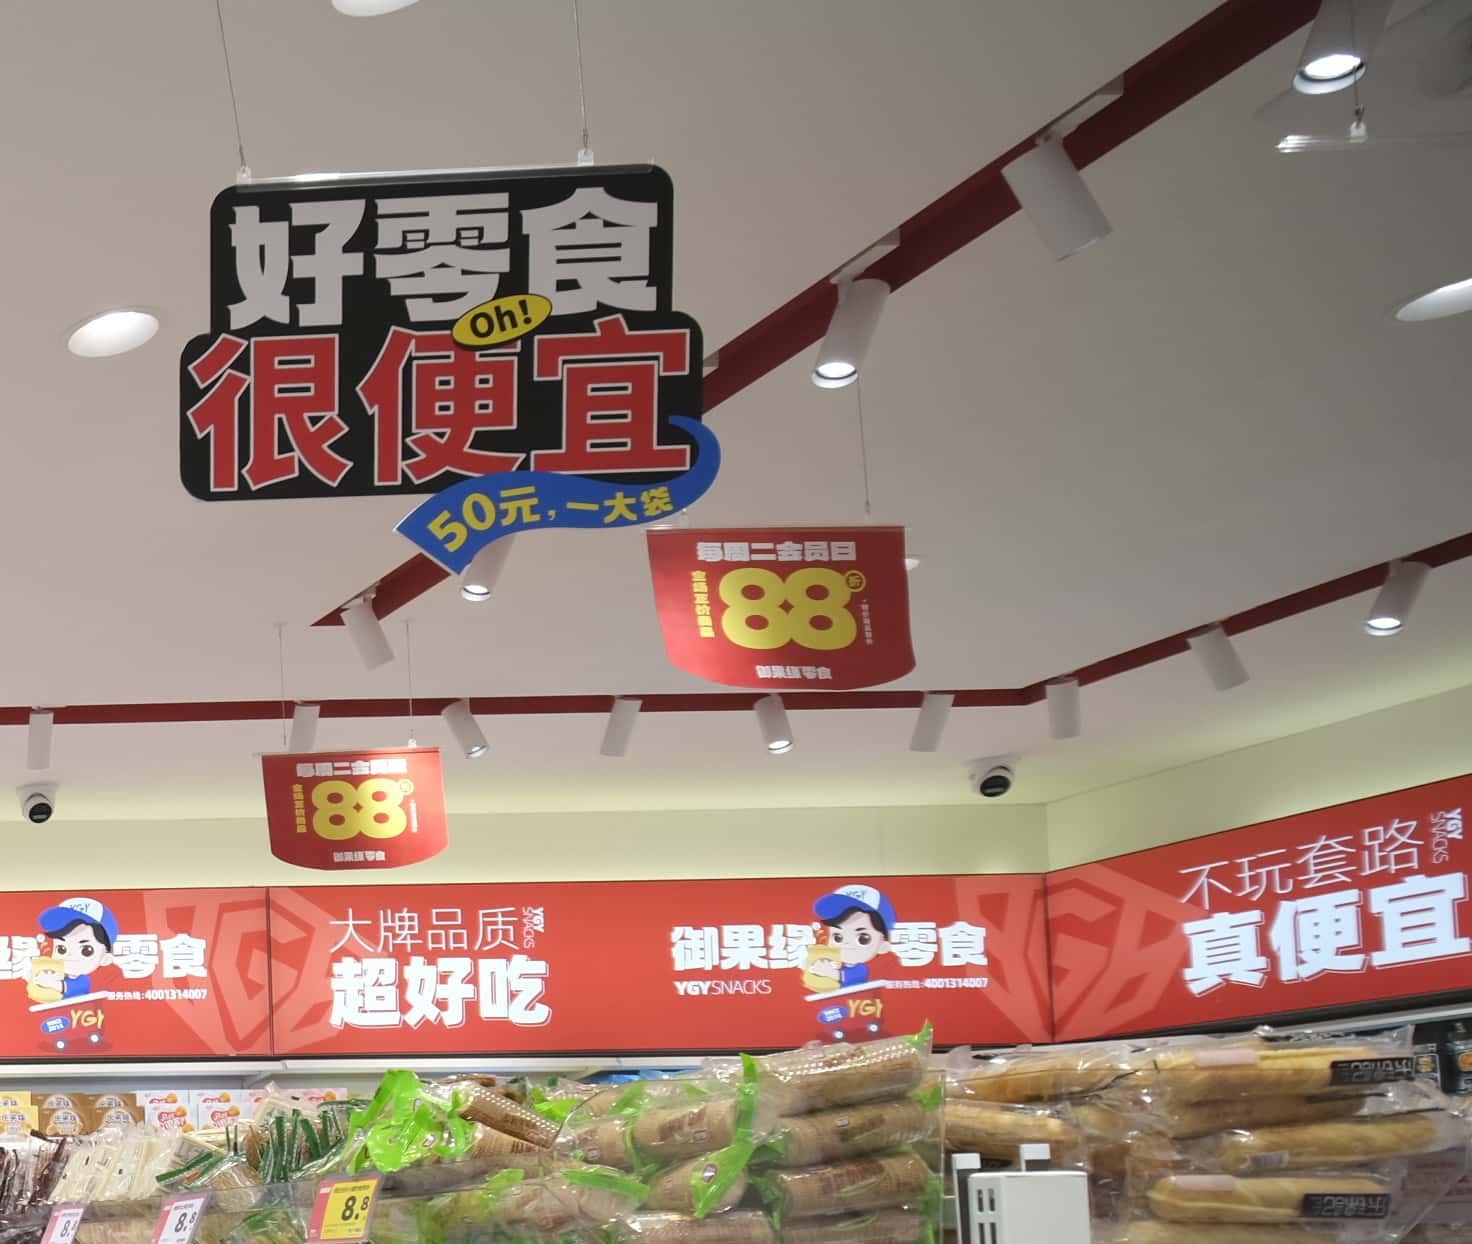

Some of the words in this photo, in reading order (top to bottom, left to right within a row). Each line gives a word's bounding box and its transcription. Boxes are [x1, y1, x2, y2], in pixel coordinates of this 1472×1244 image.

[229, 186, 659, 332] 好零食
[468, 300, 531, 341] Oh!
[187, 314, 692, 493] 很便宜
[718, 567, 857, 650] 88
[312, 778, 408, 841] 88
[1178, 818, 1424, 910] 不玩套路
[113, 933, 208, 979] 零食
[329, 907, 520, 953] 大牌品质
[671, 924, 818, 971] 御果缘
[890, 921, 988, 967] 零食
[1183, 872, 1472, 997] 真便宜
[330, 954, 552, 1029] 超好吃
[174, 1210, 197, 1233] 8.8
[341, 1191, 370, 1221] 8.8
